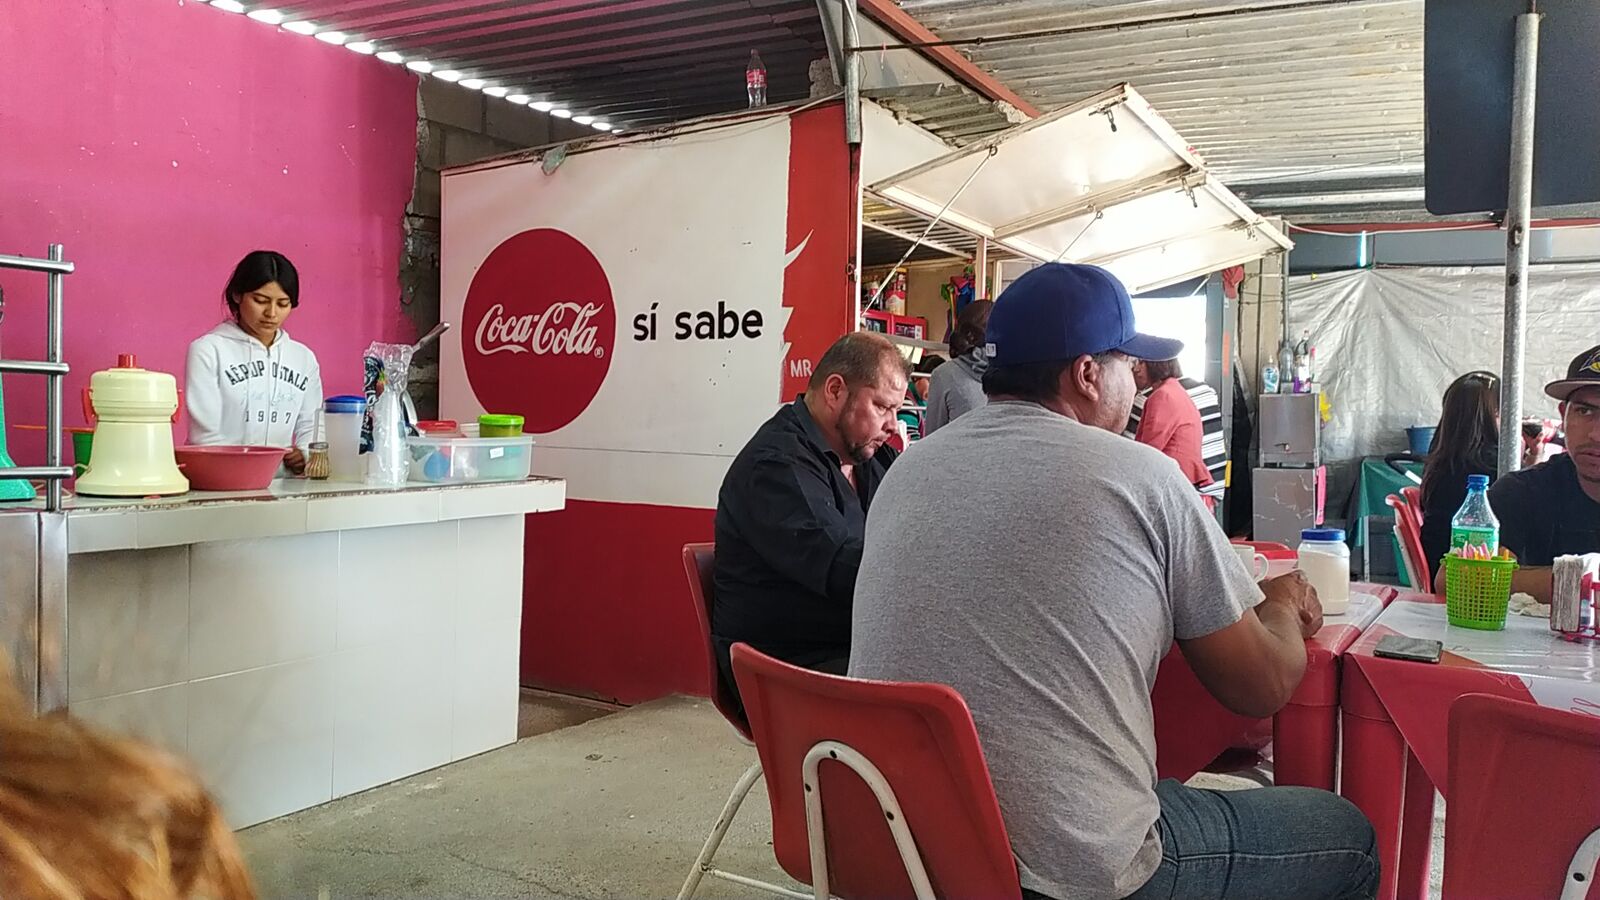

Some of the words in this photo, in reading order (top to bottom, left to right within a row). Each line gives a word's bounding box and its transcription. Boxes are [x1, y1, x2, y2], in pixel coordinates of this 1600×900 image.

[474, 302, 605, 355] Coca-Cola
[633, 302, 659, 341] sí
[674, 300, 764, 341] sabe
[790, 358, 813, 378] MR
